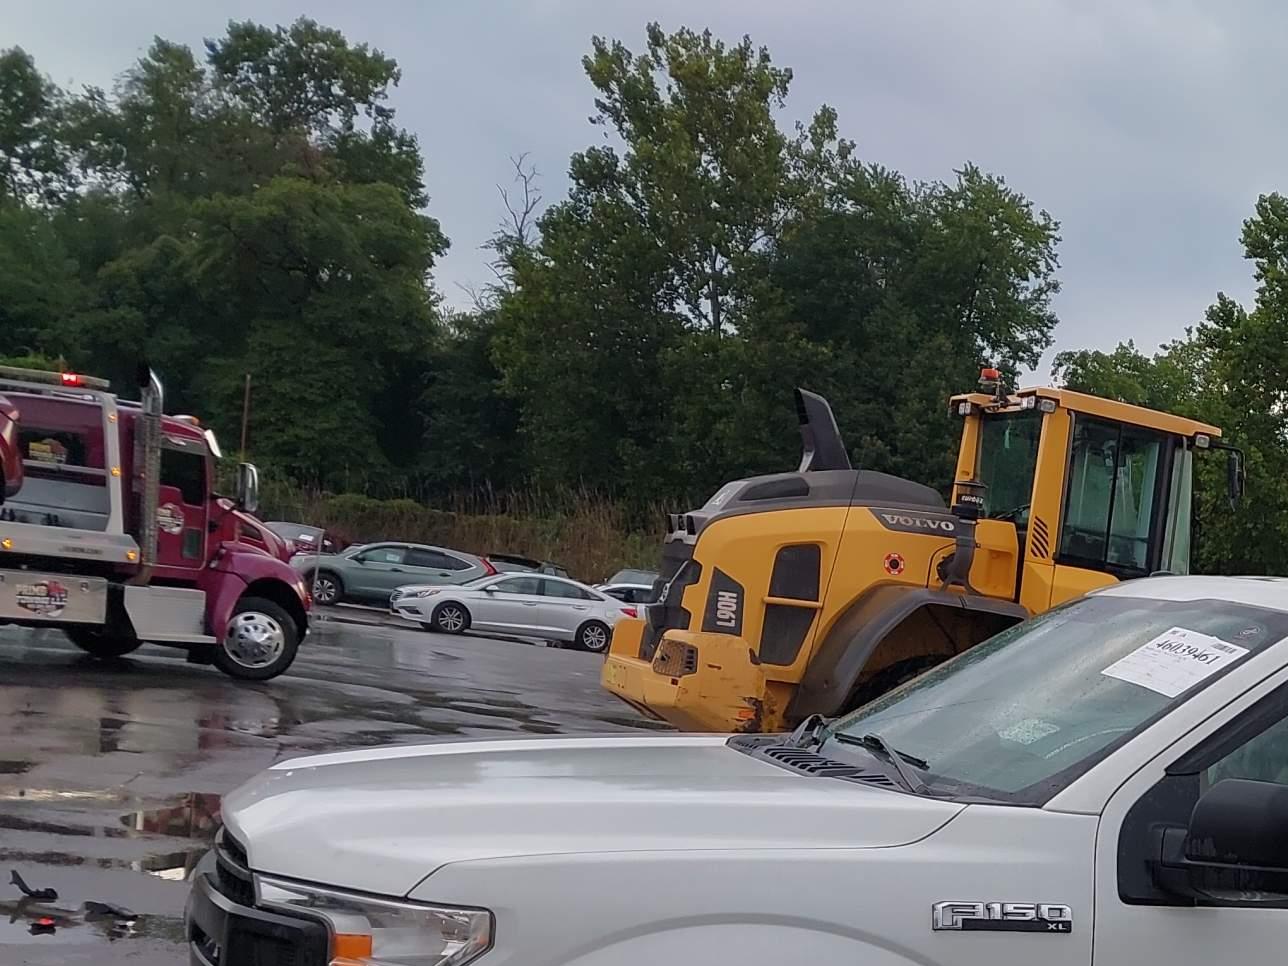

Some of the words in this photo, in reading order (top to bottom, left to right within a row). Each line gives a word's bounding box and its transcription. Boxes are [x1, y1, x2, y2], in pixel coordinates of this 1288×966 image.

[881, 514, 955, 531] VOLVO
[716, 591, 738, 627] L90H
[1156, 640, 1221, 664] 46039461
